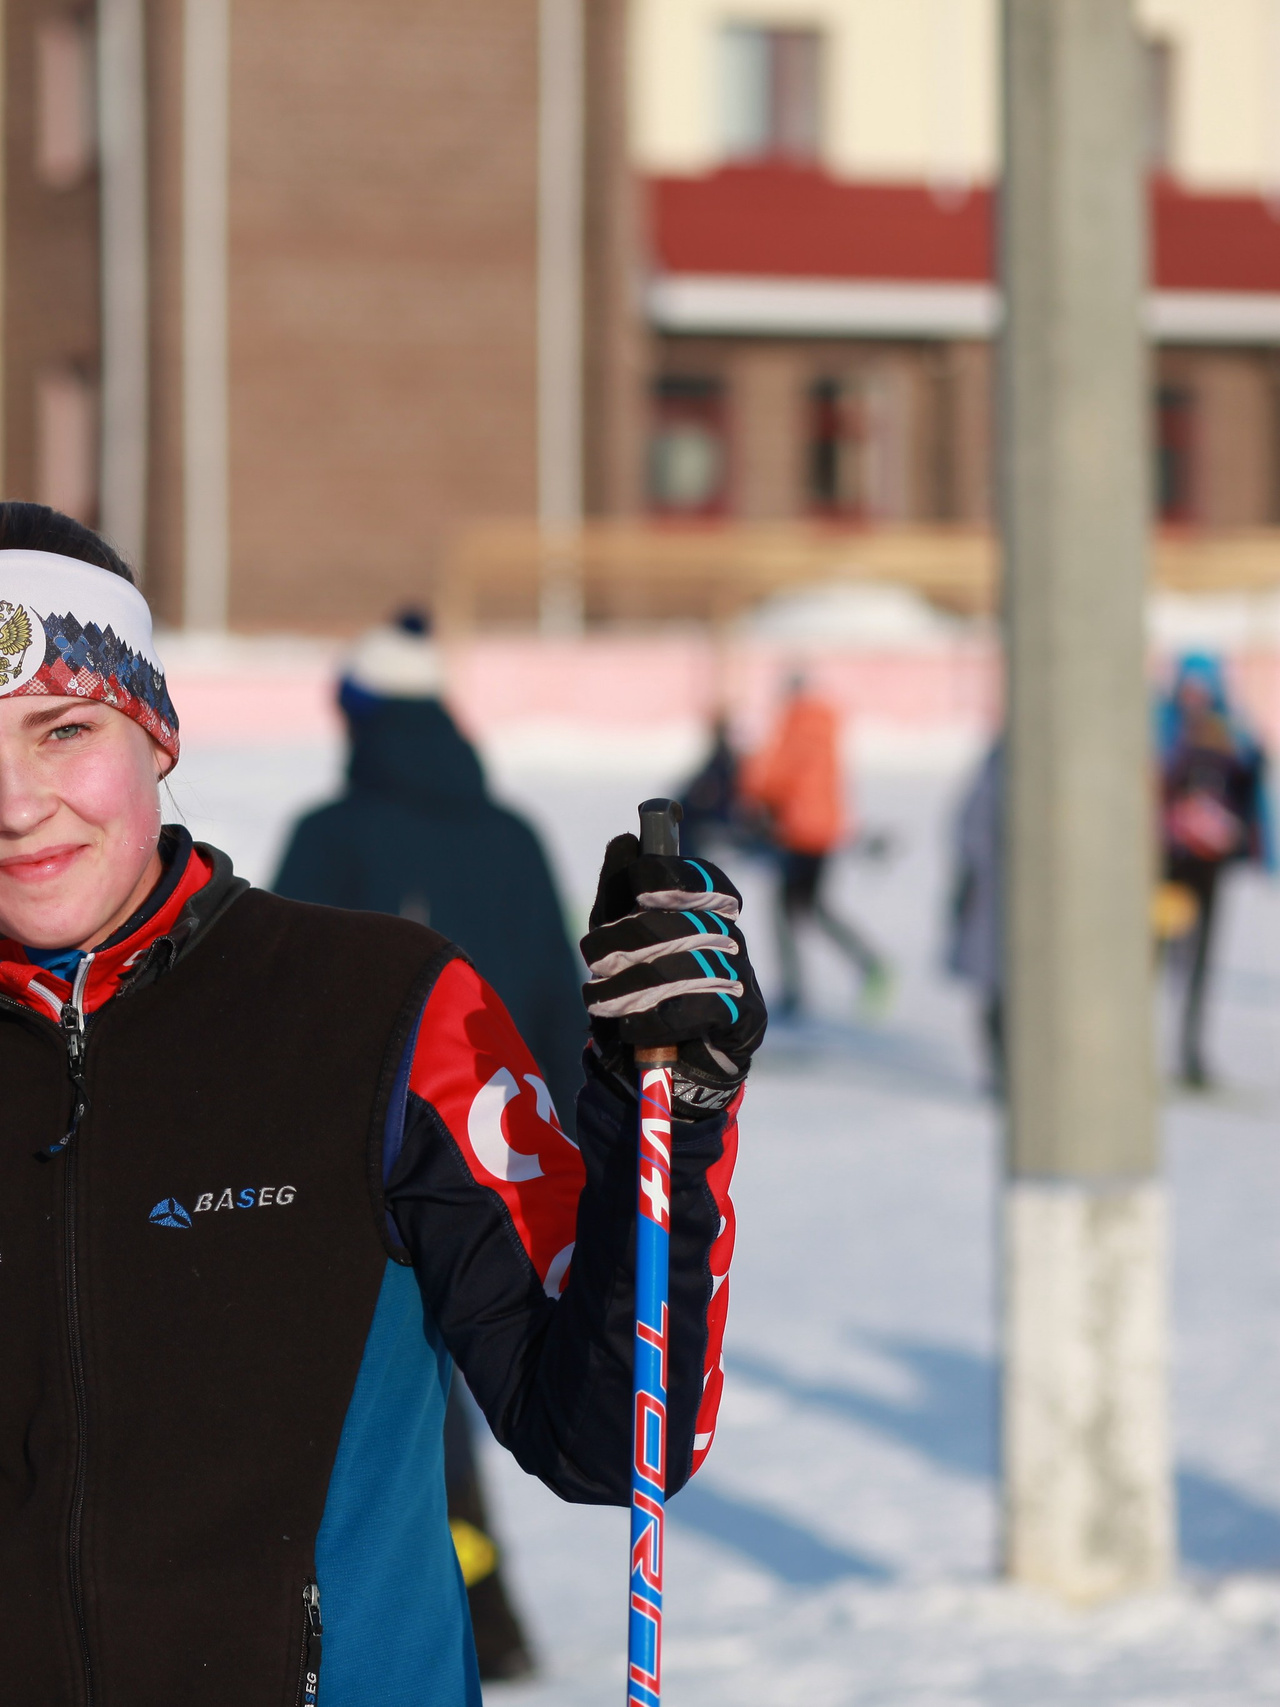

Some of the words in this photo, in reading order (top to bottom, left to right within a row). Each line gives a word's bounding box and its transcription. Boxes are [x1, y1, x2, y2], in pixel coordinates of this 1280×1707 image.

[193, 1185, 297, 1213] BASEG
[628, 1301, 668, 1707] TORN
[304, 1672, 317, 1707] SEG
